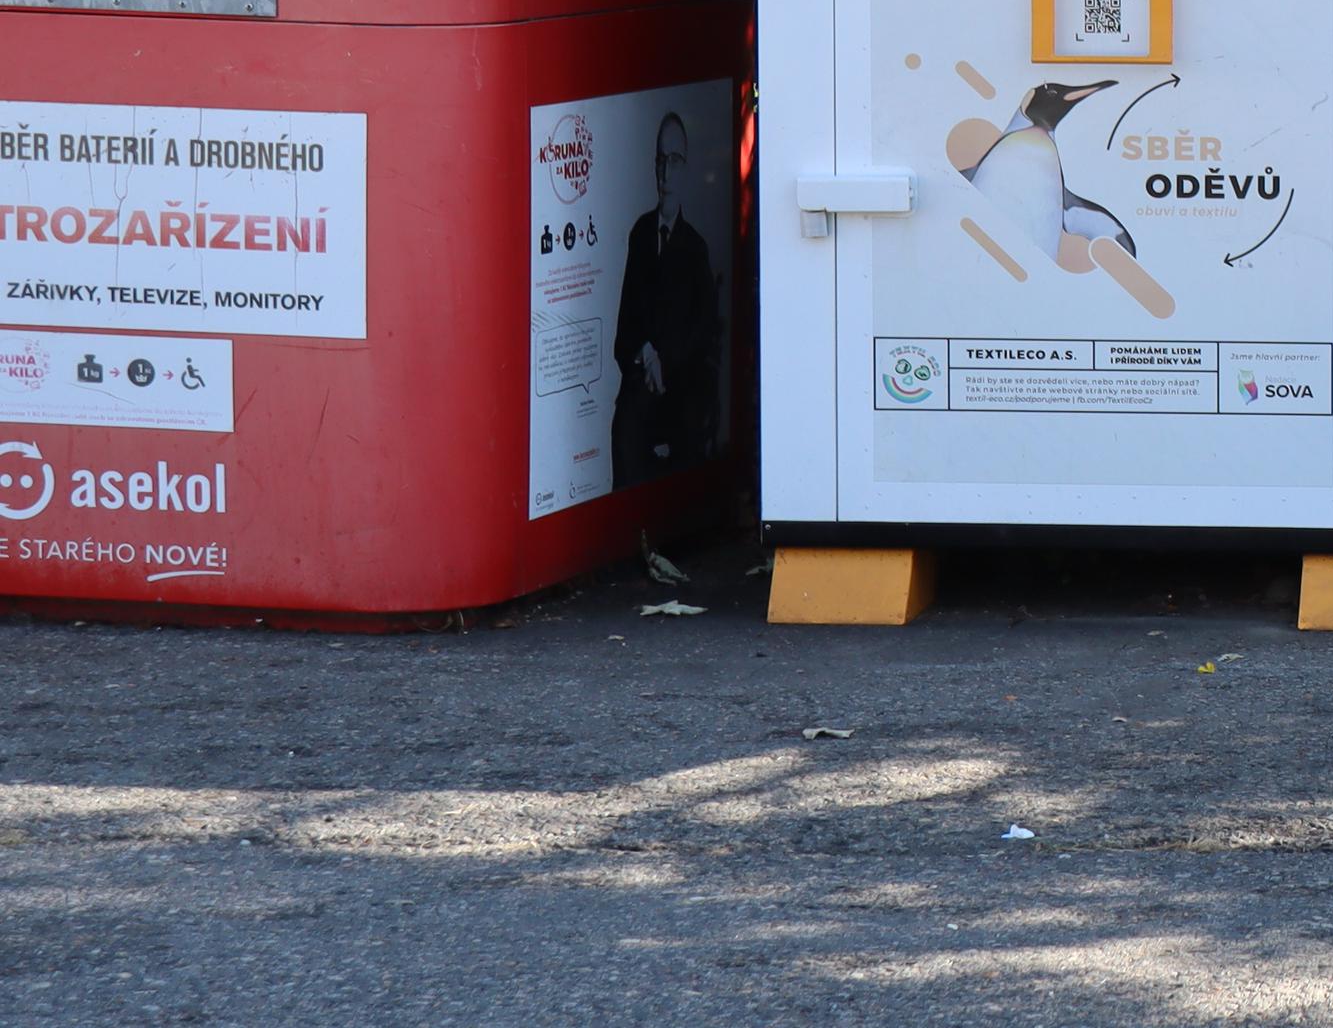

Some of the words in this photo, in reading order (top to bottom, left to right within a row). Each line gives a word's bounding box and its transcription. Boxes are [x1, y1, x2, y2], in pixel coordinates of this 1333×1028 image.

[60, 128, 155, 166] BATERIÍ
[164, 139, 180, 167] A
[190, 133, 325, 172] DROBNÉHO
[1121, 129, 1222, 161] SBĚR
[564, 159, 589, 180] KILO
[1146, 166, 1281, 200] ODĚVŮ
[1136, 205, 1176, 216] obuvi
[1179, 208, 1189, 216] a
[1192, 205, 1238, 217] textilu
[7, 279, 101, 304] ZÁŘIVKY,
[107, 286, 208, 310] TELEVIZE,
[215, 291, 324, 311] MONITORY
[966, 349, 1046, 360] TEXTILECO
[1049, 350, 1077, 361] A.S.
[1171, 347, 1202, 356] LIDEM
[1255, 353, 1283, 361] hlavní
[1285, 354, 1320, 363] partner:
[1115, 356, 1155, 365] PŘÍRODĚ
[1157, 357, 1179, 365] DÍKY
[1181, 357, 1202, 366] VÁM
[8, 367, 44, 378] KILO
[1092, 378, 1113, 386] nebo
[1115, 378, 1138, 386] máte
[1141, 378, 1165, 388] dobrý
[1168, 379, 1200, 388] nápad?
[1049, 386, 1083, 394] webové
[1120, 387, 1143, 395] nebo
[1145, 387, 1179, 395] sociální
[1265, 384, 1314, 398] SOVA
[70, 460, 226, 513] asekol
[19, 537, 136, 563] STARÉHO
[146, 542, 228, 567] NOVÉ!
